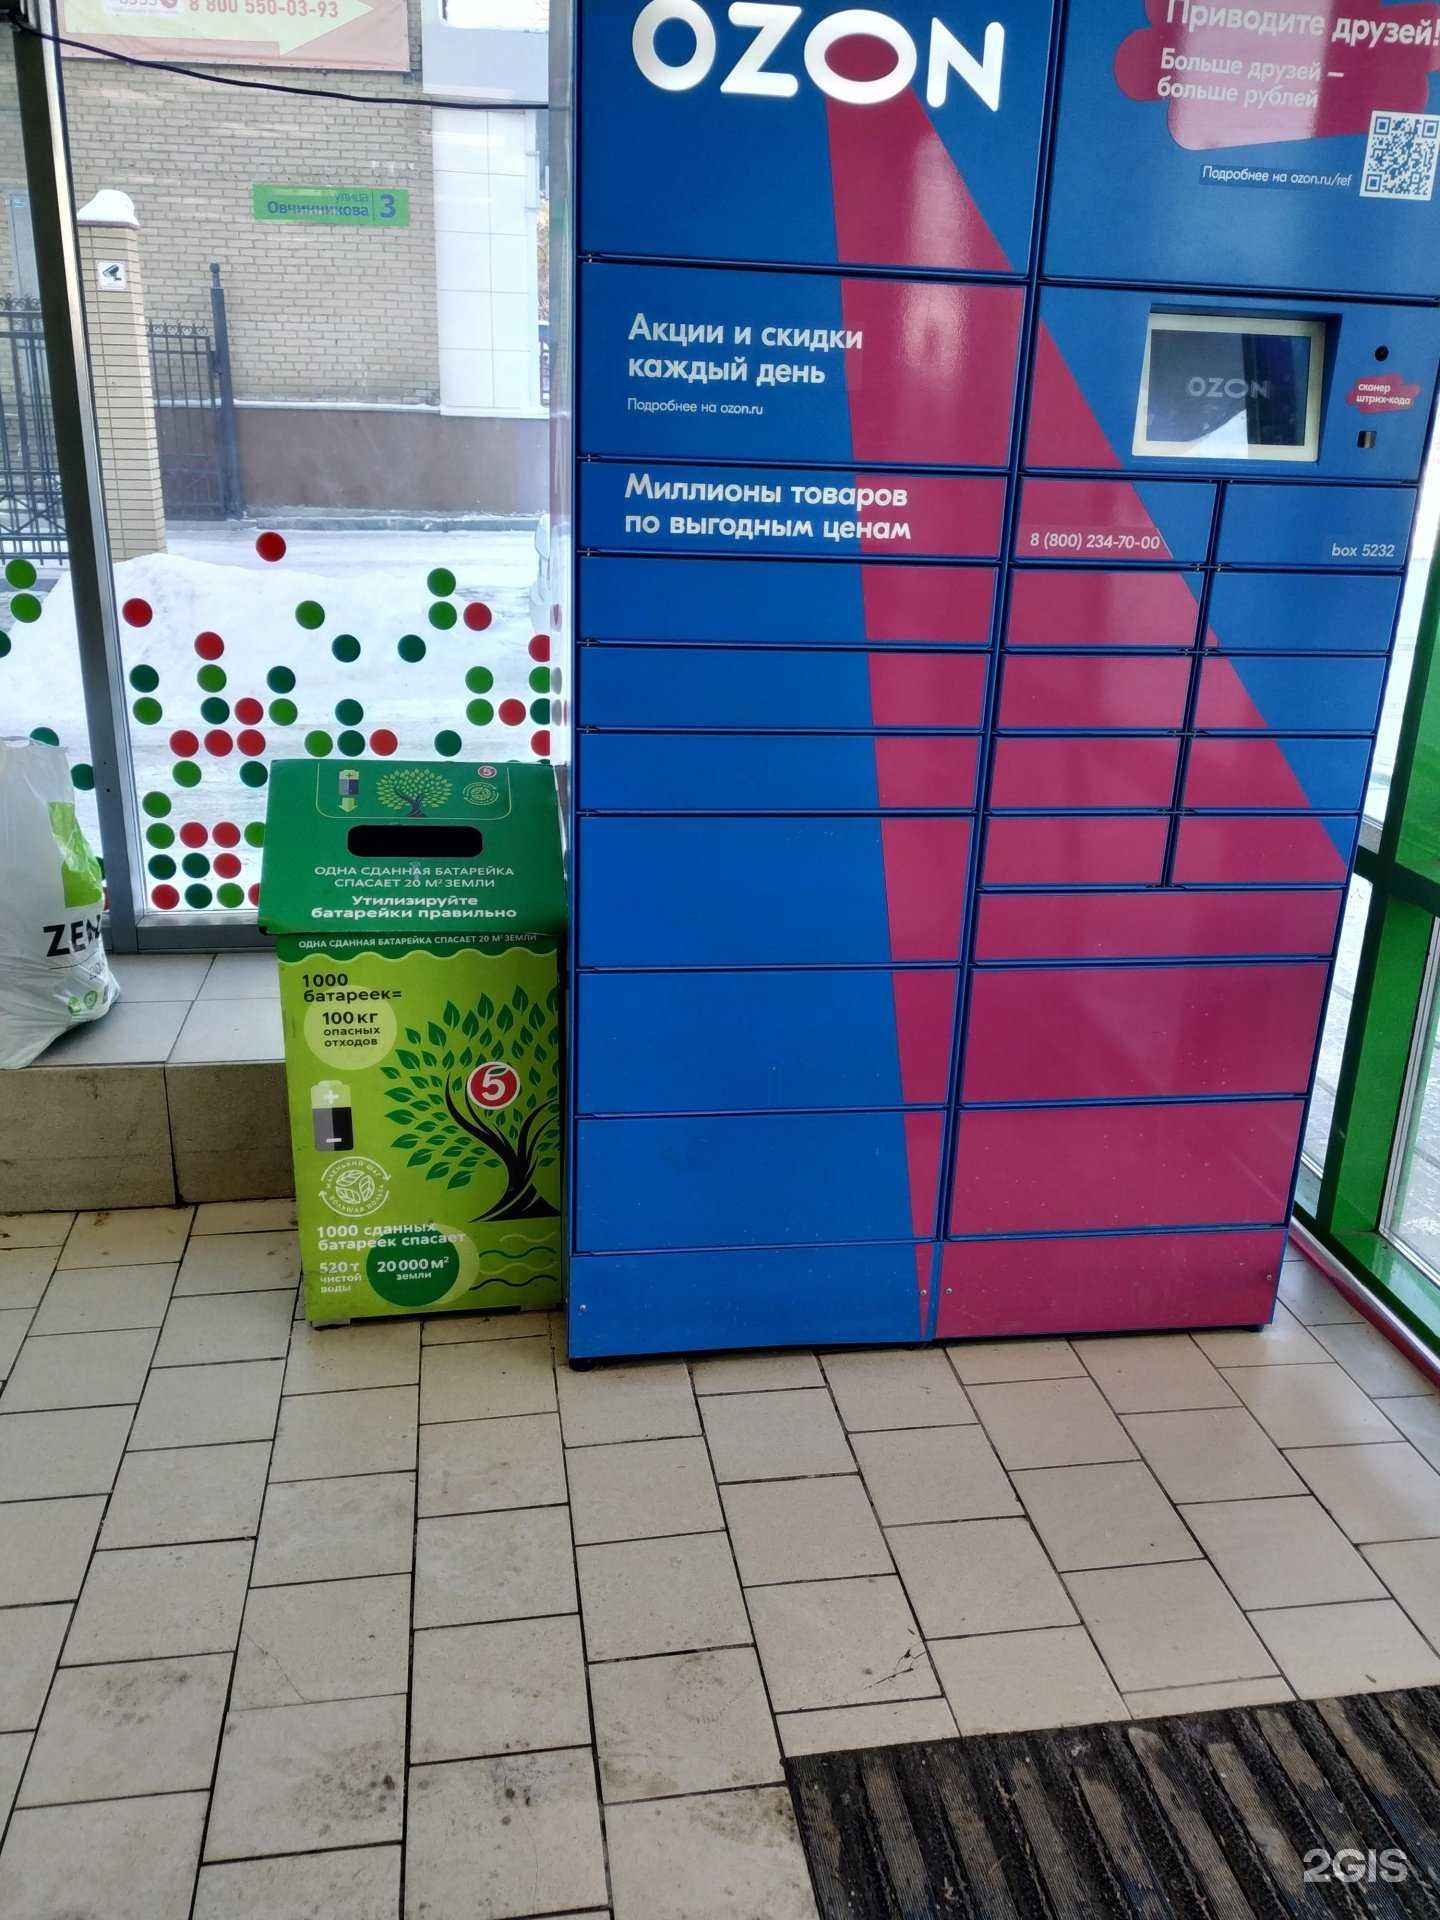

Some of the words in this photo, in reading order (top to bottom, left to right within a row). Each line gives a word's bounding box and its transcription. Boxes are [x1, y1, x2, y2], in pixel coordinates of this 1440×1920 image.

[1166, 0, 1326, 37] Приводите
[1331, 18, 1440, 48] друзей!
[632, 0, 1005, 112] OZON
[1160, 47, 1243, 75] Больше
[1248, 61, 1323, 83] друзей
[1157, 75, 1239, 101] больше
[1244, 84, 1319, 109] рублей
[1202, 165, 1270, 183] Подробнее
[1272, 173, 1287, 183] на
[1290, 172, 1353, 188] ozon.ru/ref
[380, 194, 396, 219] 3
[628, 312, 724, 347] Акции
[734, 326, 752, 345] и
[761, 326, 863, 352] скидки
[628, 356, 748, 385] каждый
[756, 362, 826, 387] день
[1187, 376, 1271, 400] OZON
[1358, 383, 1391, 395] сканер
[627, 397, 698, 414] Подробнее
[701, 403, 717, 413] на
[720, 405, 763, 416] ozon.ru
[625, 473, 782, 504] Миллионы
[790, 486, 908, 511] товаров
[625, 515, 660, 534] по
[670, 515, 813, 540] выгодным
[823, 520, 911, 542] ценам
[1030, 532, 1040, 546] 8
[1044, 532, 1083, 550] (800)
[1086, 534, 1160, 550] 234-70-00
[1332, 543, 1358, 557] box
[1361, 543, 1396, 557] 5232
[314, 866, 357, 876] ОДНА
[360, 866, 431, 877] СДАННАЯ
[435, 865, 514, 876] БАТАРЕЙКА
[334, 879, 401, 888] СПАСАЕТ
[404, 879, 420, 888] 20
[445, 879, 495, 888] ЗЕМЛИ
[352, 895, 478, 907] Утилизируйте
[311, 907, 412, 920] батарейки
[418, 909, 517, 920] правильно
[298, 939, 327, 949] ОДНА
[329, 938, 376, 948] СДАННАЯ
[378, 936, 432, 946] БАТАРЕЙКА
[434, 935, 477, 945] СПАСАЕТ
[479, 935, 490, 943] 20
[302, 973, 349, 988] 1000
[323, 1027, 380, 1036] опасных
[324, 1038, 378, 1048] отходов
[318, 1224, 358, 1239] 1000
[364, 1222, 436, 1236] сданных
[318, 1236, 396, 1252] батареек
[401, 1233, 466, 1247] спасает
[320, 1273, 362, 1284] чистой
[396, 1272, 432, 1281] земли
[320, 1286, 351, 1294] воды
